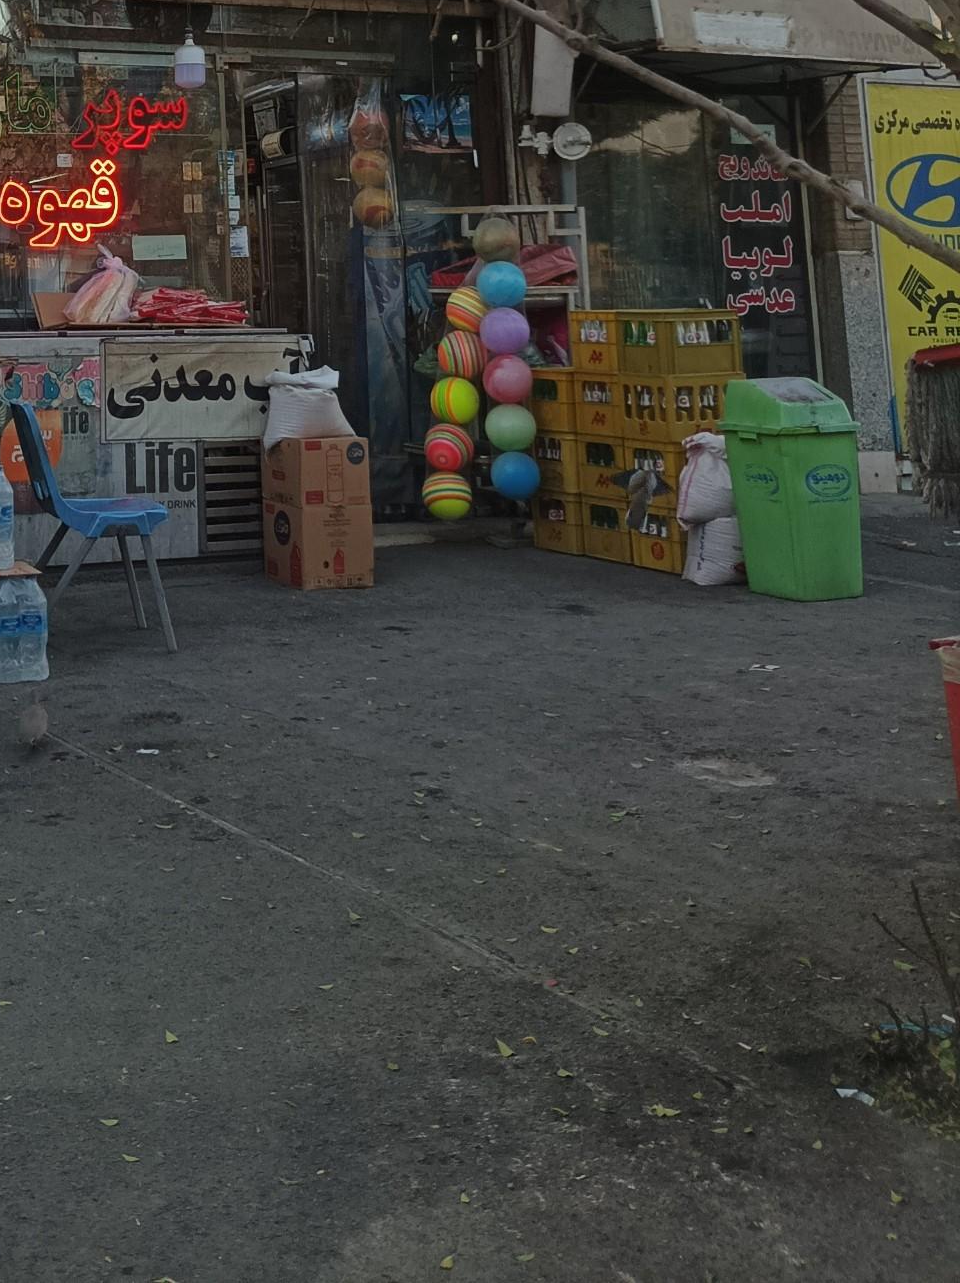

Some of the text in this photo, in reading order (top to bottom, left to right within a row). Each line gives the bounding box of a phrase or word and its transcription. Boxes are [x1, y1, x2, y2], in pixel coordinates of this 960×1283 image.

[72, 88, 189, 155] سوپر
[874, 108, 910, 135] مرکزی
[721, 235, 794, 280] لوبیا
[727, 285, 796, 316] عدسی
[907, 326, 938, 337] CAR
[106, 353, 237, 420] معدنی
[62, 407, 89, 434] ife
[125, 442, 196, 494] Life
[167, 499, 196, 509] DRINK
